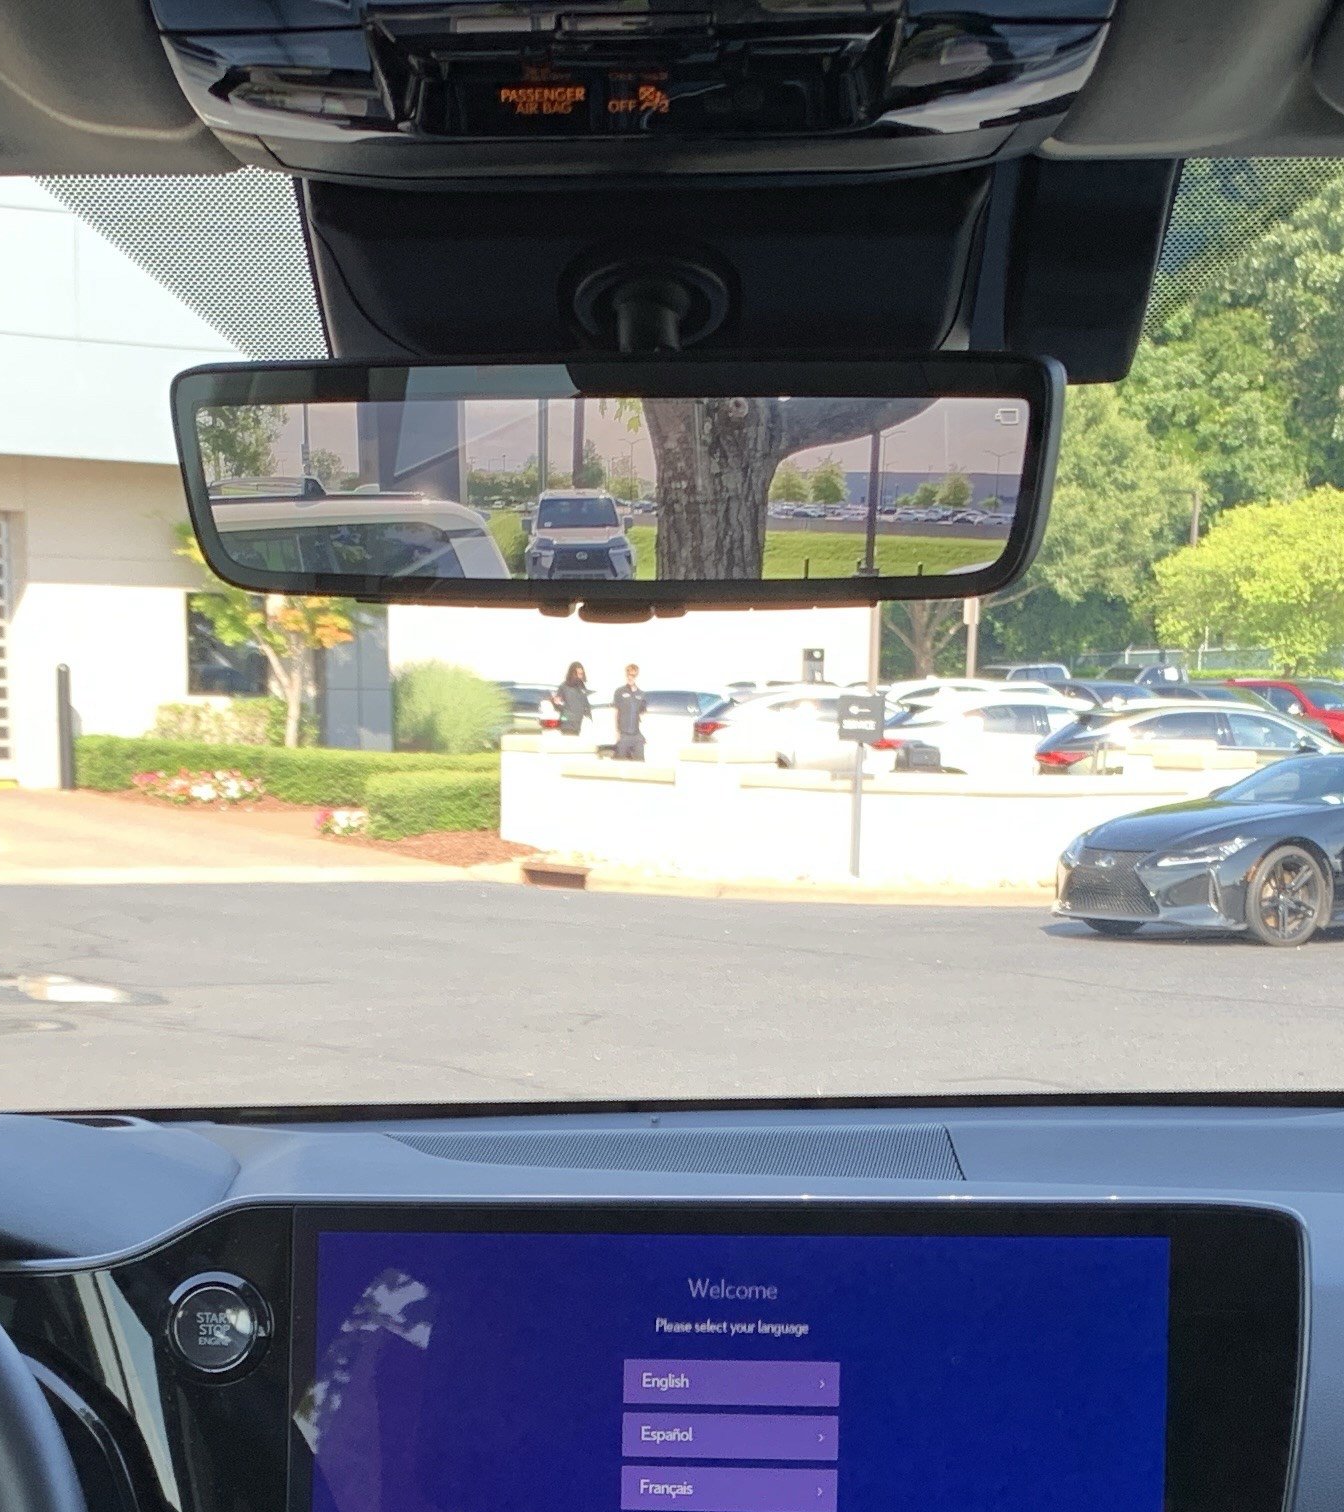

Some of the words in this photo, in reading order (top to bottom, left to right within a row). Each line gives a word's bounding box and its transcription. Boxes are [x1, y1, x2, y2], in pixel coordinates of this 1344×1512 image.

[500, 86, 586, 102] PASSENGER
[515, 101, 539, 115] AIR
[542, 101, 574, 115] BAG
[608, 99, 636, 113] OFF
[688, 1277, 778, 1301] Welcome
[196, 1312, 233, 1323] STAR
[199, 1324, 230, 1335] STOP
[655, 1317, 693, 1333] Please
[694, 1318, 727, 1334] select
[730, 1321, 755, 1337] your
[757, 1320, 809, 1338] language
[641, 1372, 690, 1391] English
[640, 1425, 693, 1445] Español
[639, 1478, 693, 1499] Français
